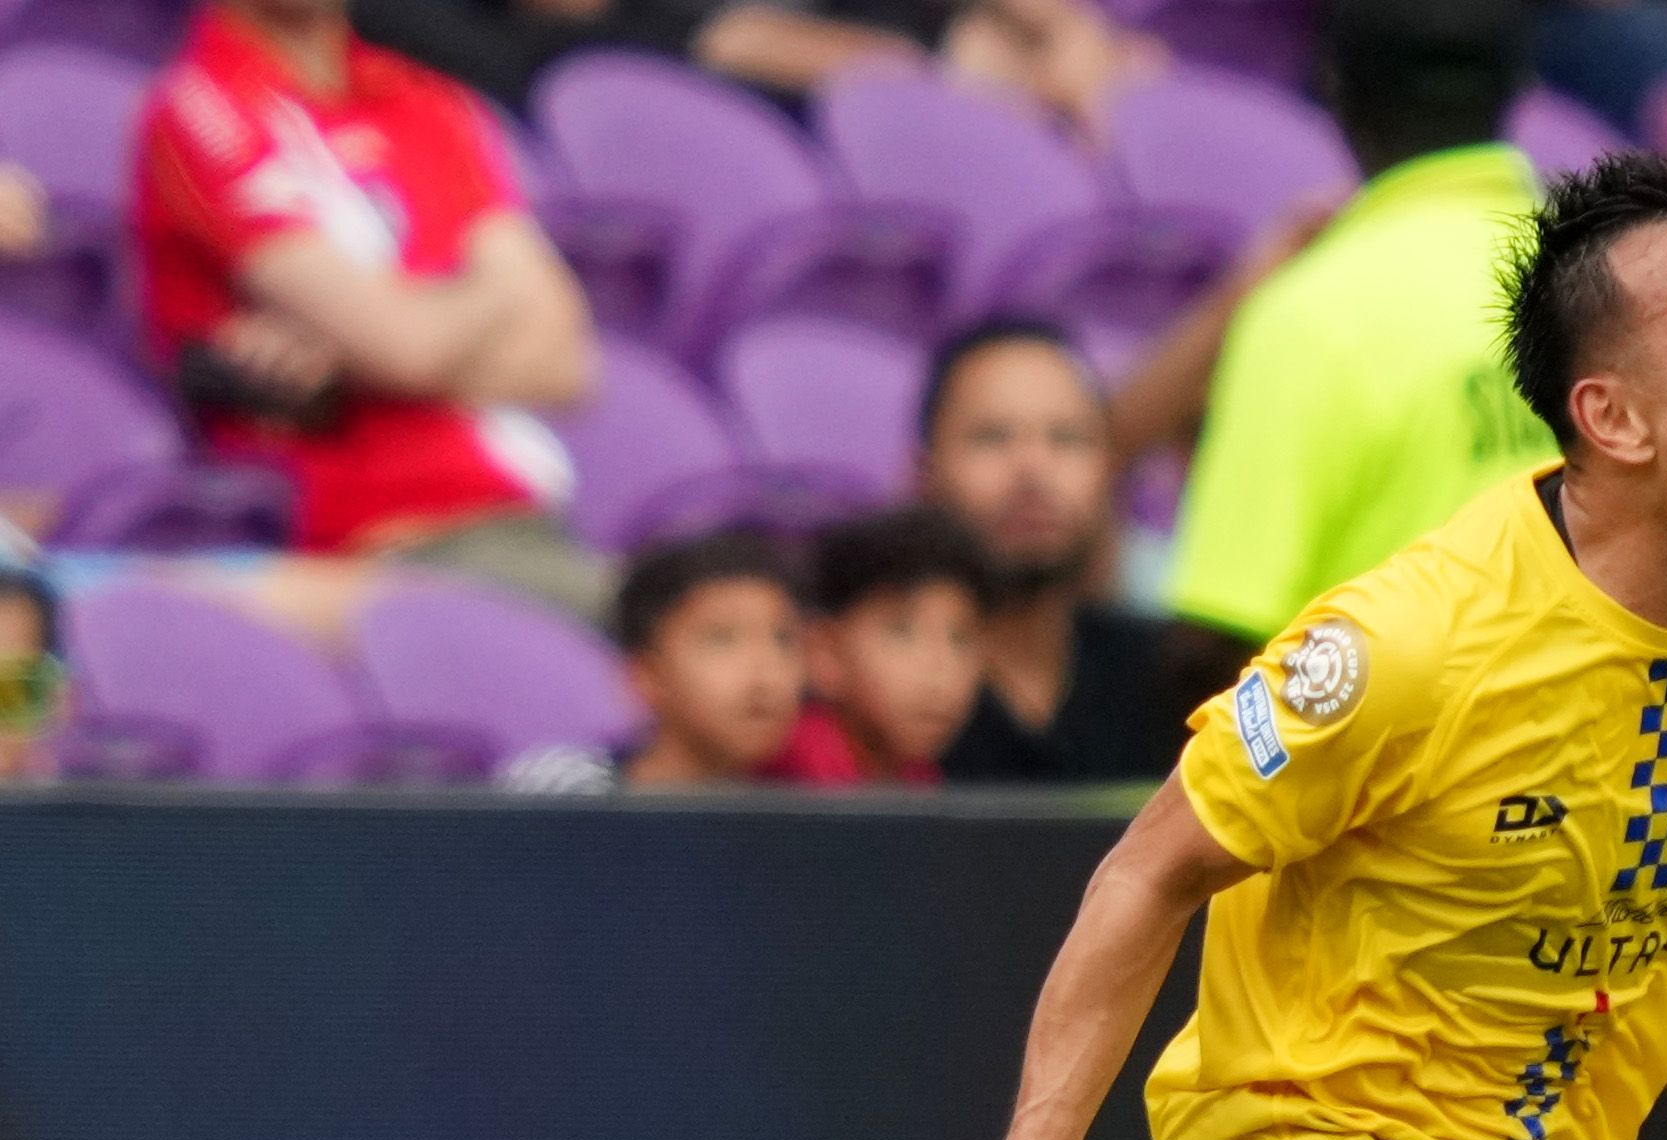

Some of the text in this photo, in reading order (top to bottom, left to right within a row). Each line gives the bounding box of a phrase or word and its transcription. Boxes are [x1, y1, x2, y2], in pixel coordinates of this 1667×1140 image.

[1346, 648, 1358, 679] CUP
[1339, 682, 1354, 701] 25
[1314, 698, 1340, 714] USA
